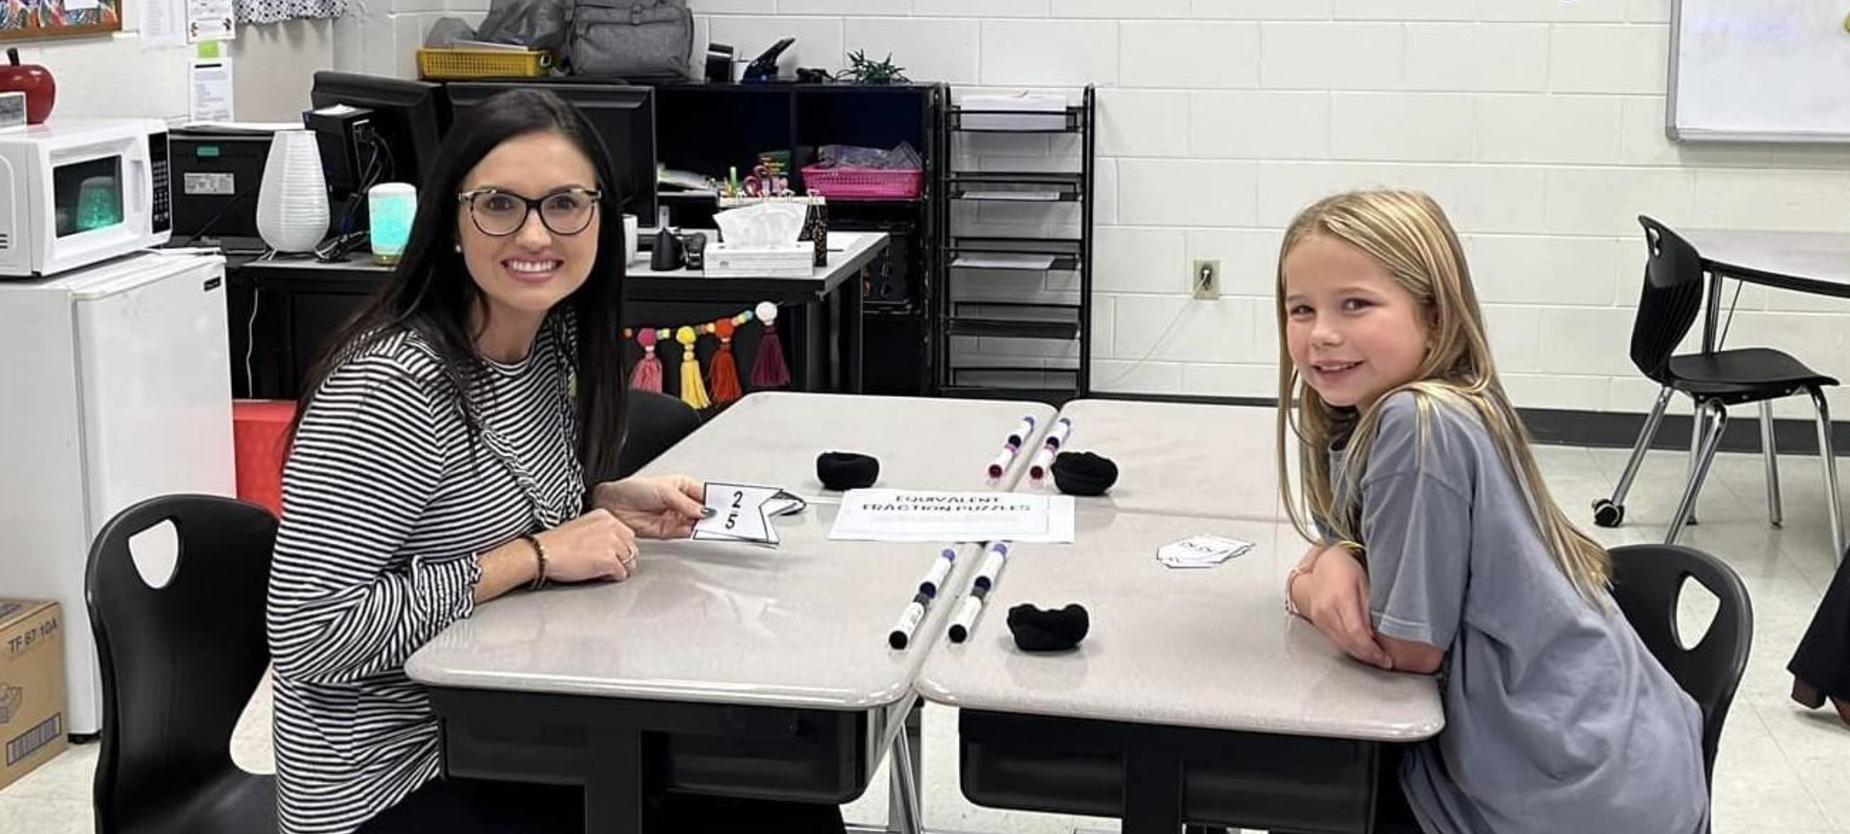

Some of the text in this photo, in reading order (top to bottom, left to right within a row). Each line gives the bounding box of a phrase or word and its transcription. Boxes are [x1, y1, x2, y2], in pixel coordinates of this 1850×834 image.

[732, 490, 744, 509] 2
[862, 502, 1032, 512] FRACTION PUZZLES
[895, 494, 999, 503] EQUIVALENT
[724, 512, 739, 530] 5
[8, 635, 23, 654] TF
